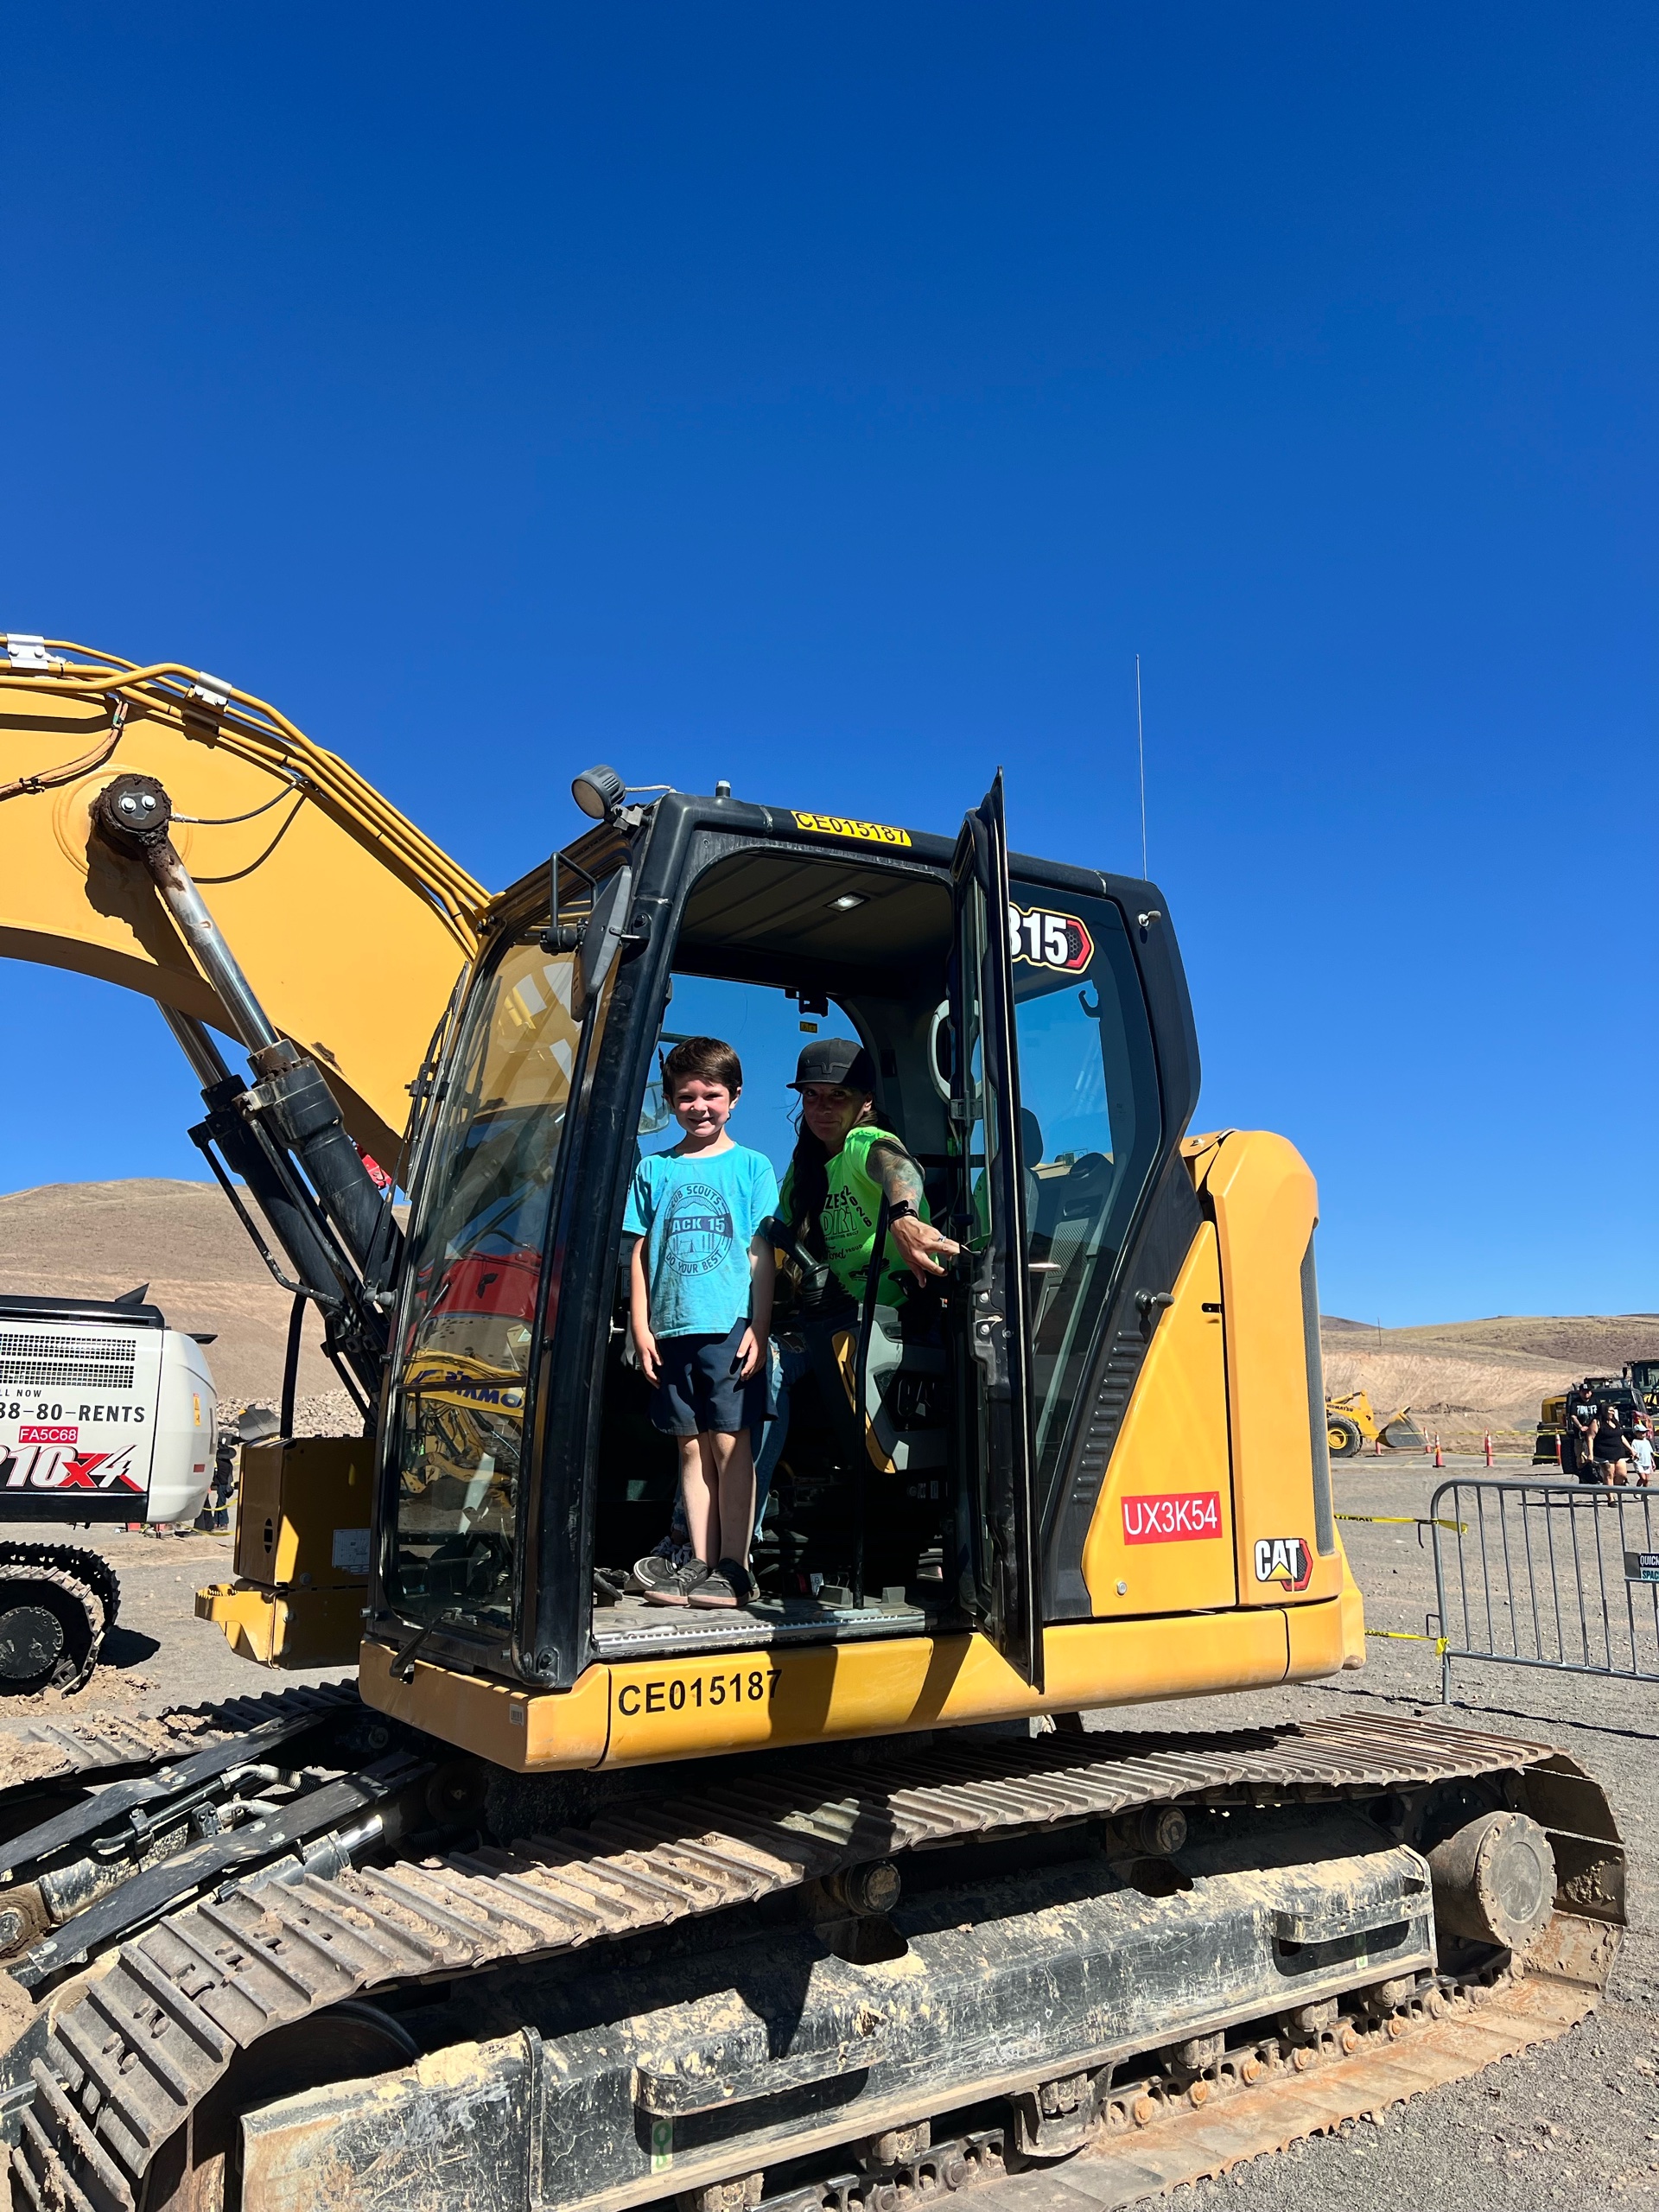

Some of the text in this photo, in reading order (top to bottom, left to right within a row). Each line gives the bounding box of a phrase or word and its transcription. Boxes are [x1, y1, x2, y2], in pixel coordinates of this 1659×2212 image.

[795, 812, 905, 843] CE015187
[687, 1185, 721, 1205] SCOUTS
[824, 1190, 848, 1209] ZES
[843, 1185, 873, 1228] 2026
[671, 1217, 726, 1233] ACK 15
[845, 1244, 863, 1254] PROUD
[665, 1249, 723, 1274] DO YOUR BEST
[16, 1389, 41, 1397] NOW
[19, 1428, 77, 1442] FA5C68
[1123, 1498, 1218, 1535] UX3K54
[1255, 1539, 1300, 1581] CAT
[618, 1669, 783, 1716] CE015187
